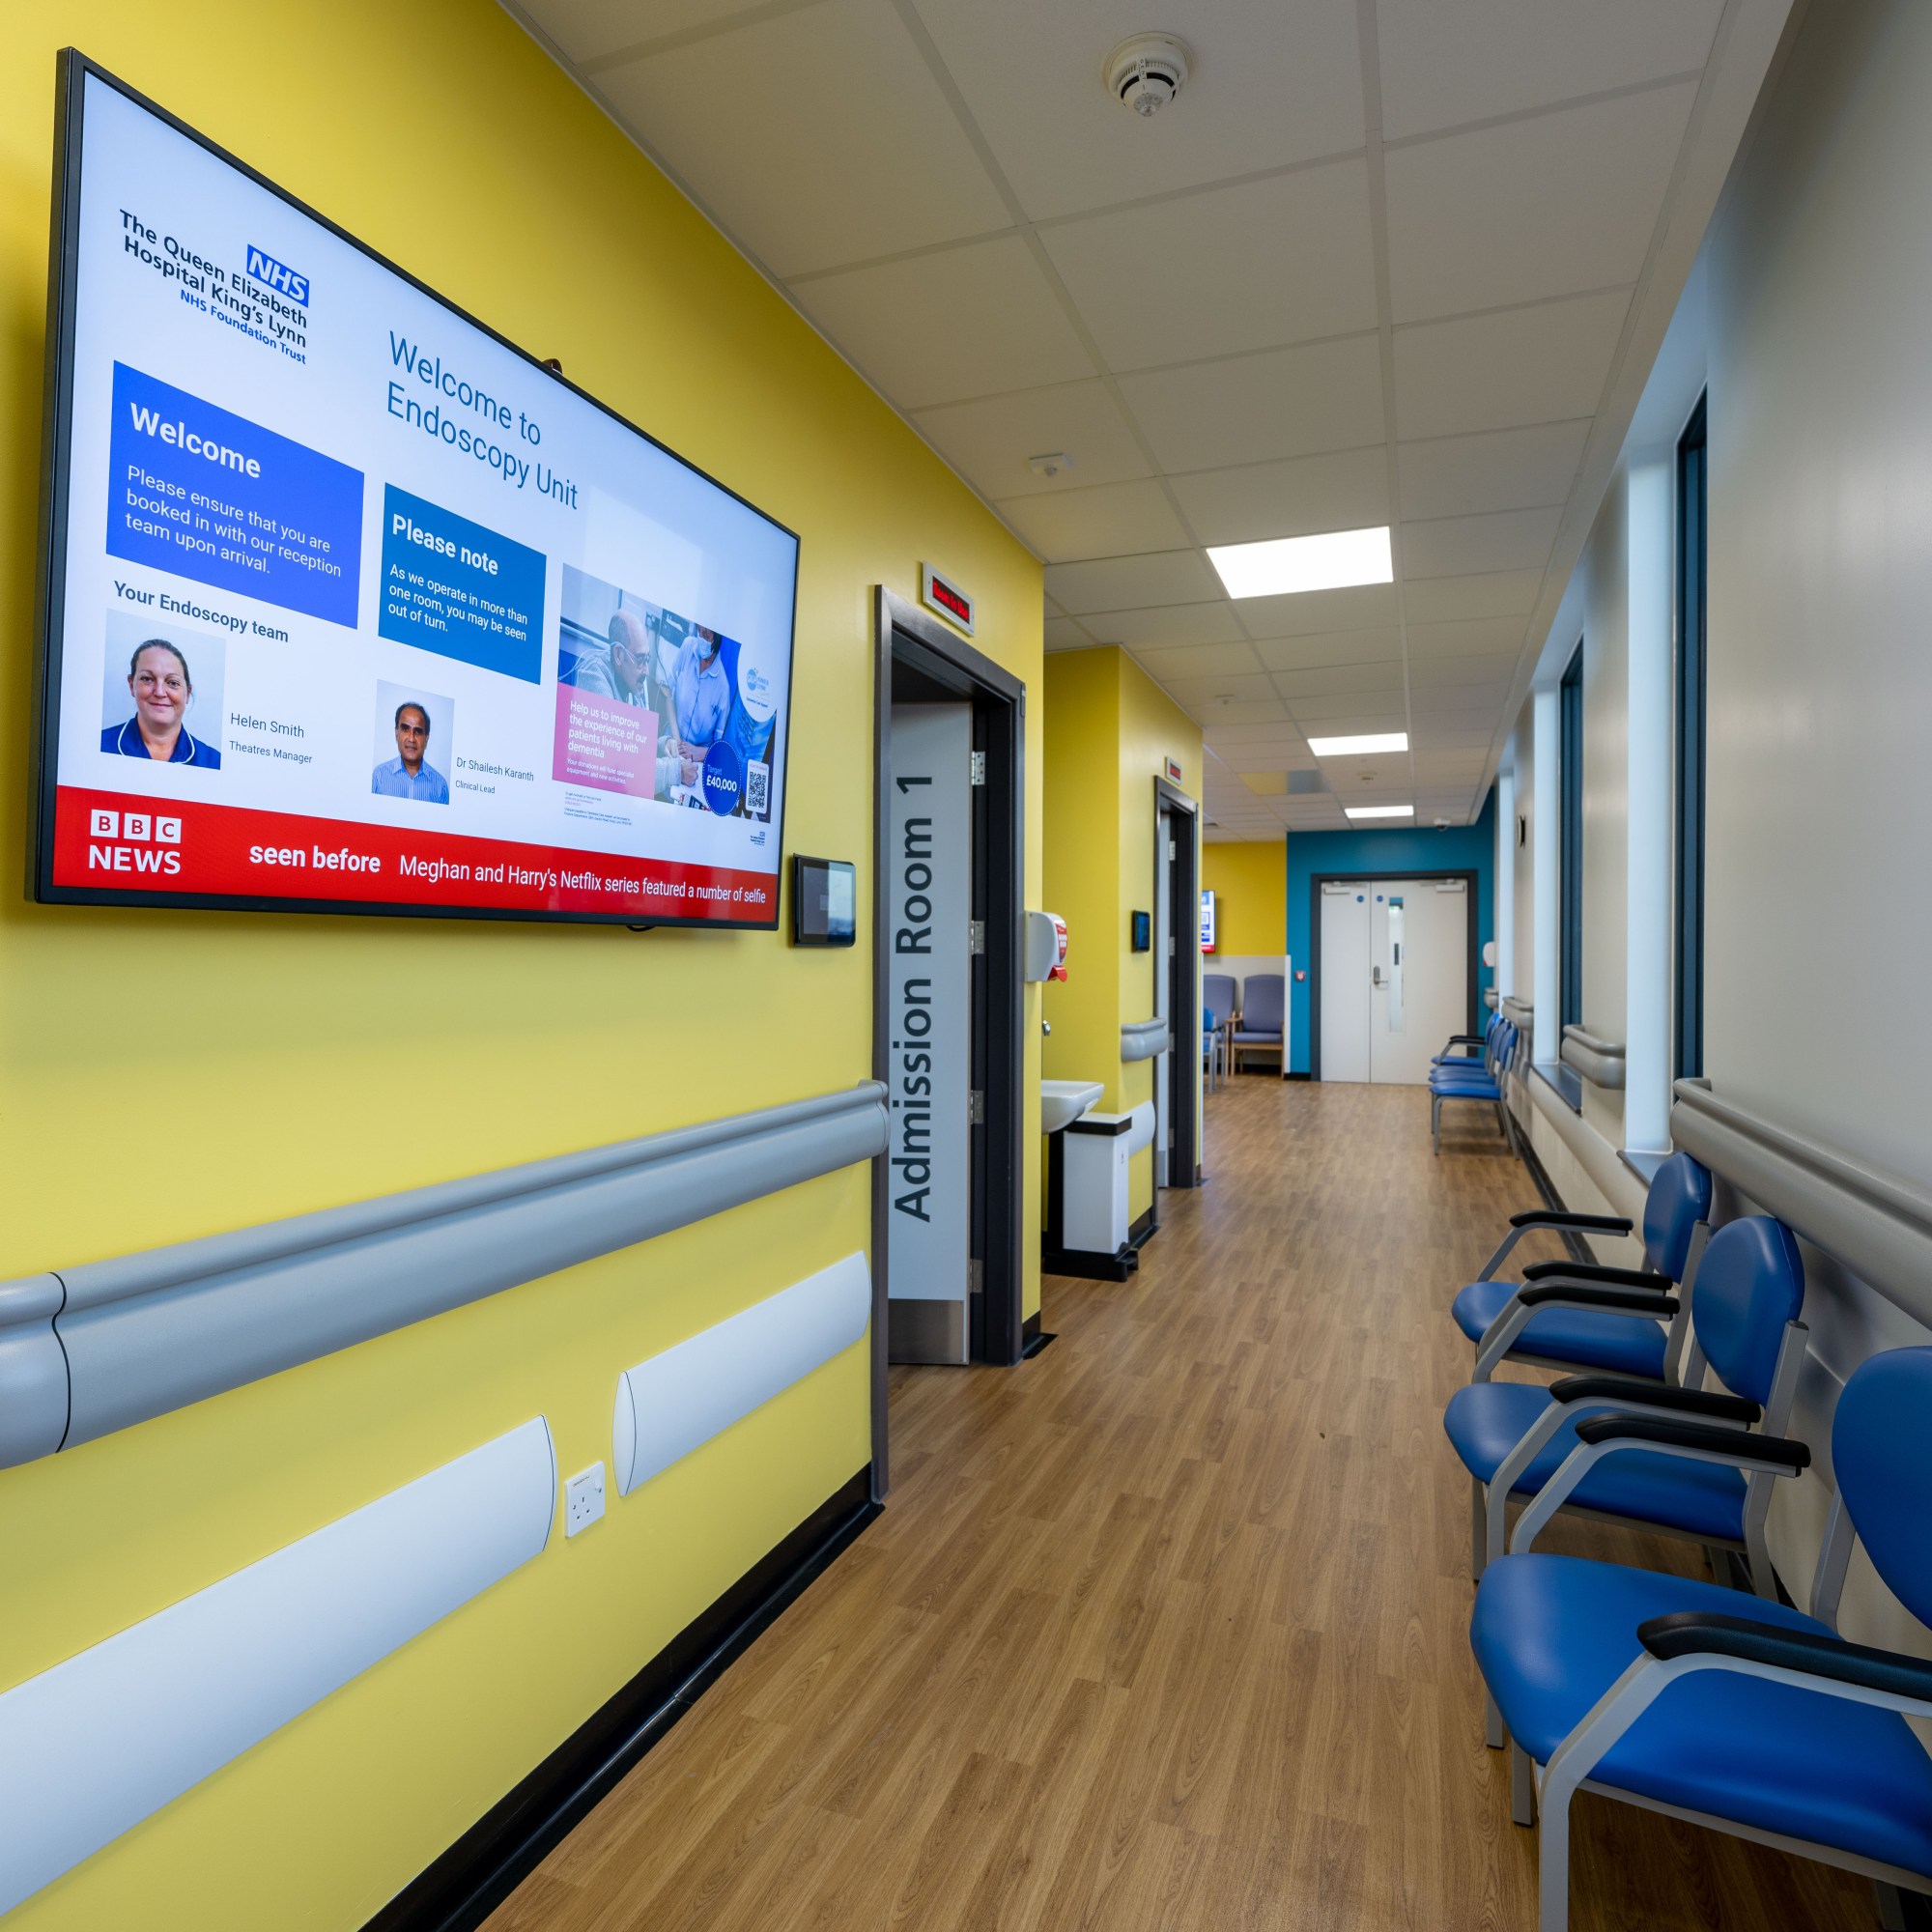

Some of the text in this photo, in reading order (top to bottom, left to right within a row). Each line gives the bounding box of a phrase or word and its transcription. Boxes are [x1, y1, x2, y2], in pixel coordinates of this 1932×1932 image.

[120, 209, 307, 328] The Queen Elizabeth
[125, 236, 305, 348] Hospital King's Lynn
[248, 250, 307, 301] NHS
[181, 290, 305, 364] NHS Foundation Trust
[390, 330, 540, 445] Welcome to
[130, 402, 261, 478] Welcome
[388, 381, 578, 509] Endoscopy Unit
[127, 489, 341, 577] booked in with our reception
[128, 465, 330, 553] Please ensure that you are
[126, 513, 270, 574] team upon arrival.
[393, 514, 497, 575] Please note
[114, 581, 289, 642] Your Endoscopy team
[388, 604, 447, 632] out of turn.
[389, 585, 526, 641] one room, you may be seen
[390, 564, 527, 625] As we operate in more than
[231, 713, 304, 738] Helen Smith
[570, 715, 647, 743] the experience of our
[571, 700, 639, 728] Help us to improve
[230, 741, 312, 763] Theatres Manager
[568, 741, 604, 757] dementia
[569, 728, 638, 753] patients living with
[456, 780, 495, 794] Clinical Lead
[457, 757, 534, 781] Dr Shailesh Karanth
[707, 764, 722, 776] Target
[707, 777, 737, 792] £40,000
[95, 812, 178, 840] BBC
[89, 844, 181, 874] NEWS
[249, 845, 381, 872] seen before
[400, 855, 765, 903] Meghan and Harry's Netflix series featured a number of selfie
[892, 777, 932, 1223] Admission Room 1
